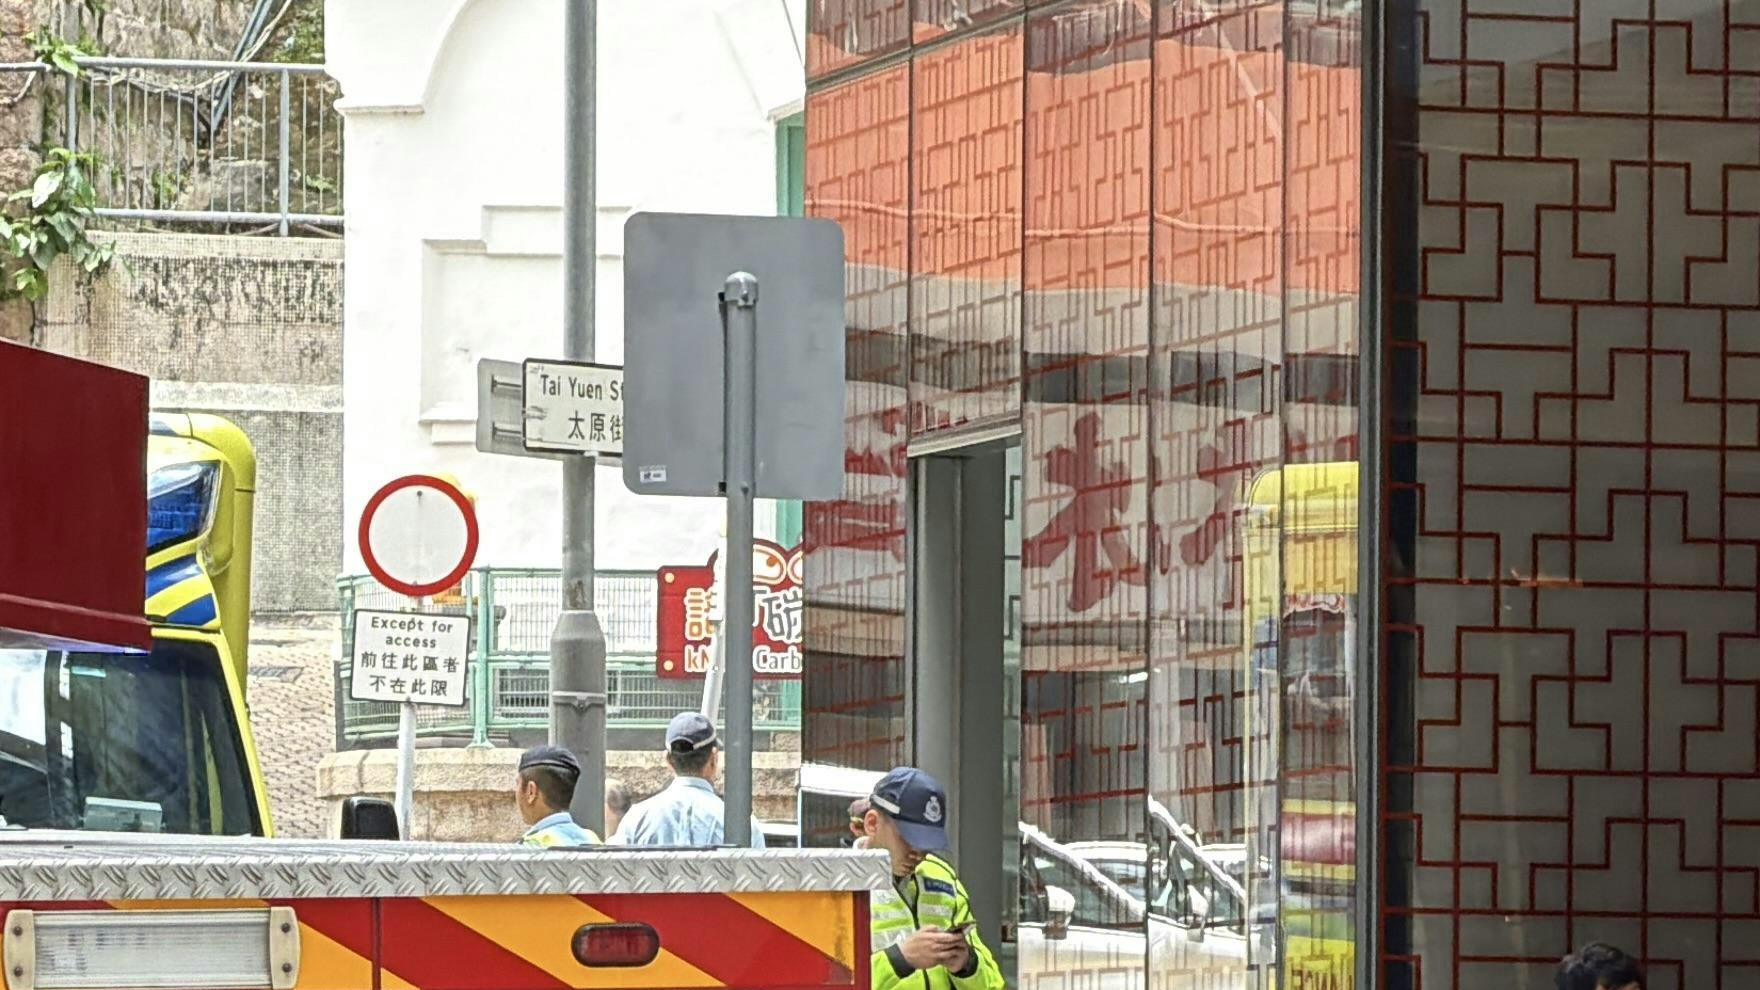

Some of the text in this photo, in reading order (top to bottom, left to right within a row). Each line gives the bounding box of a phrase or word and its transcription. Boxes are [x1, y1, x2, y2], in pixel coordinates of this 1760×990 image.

[540, 374, 561, 396] Tai
[568, 376, 602, 400] Yuen
[371, 616, 453, 633] Except for
[385, 635, 437, 648] access
[361, 652, 459, 673] 前往此區者
[369, 675, 447, 696] 不在此限
